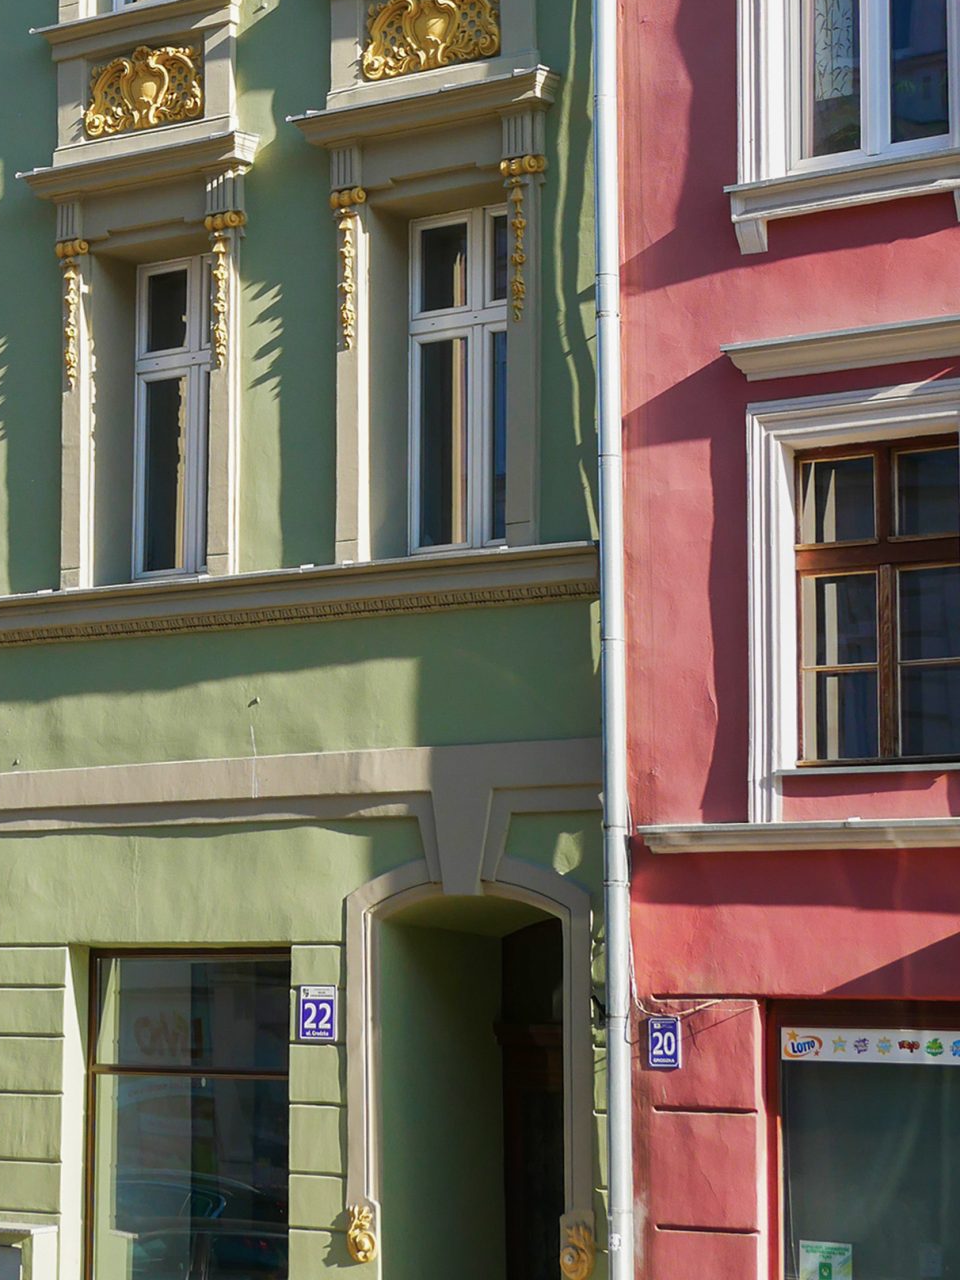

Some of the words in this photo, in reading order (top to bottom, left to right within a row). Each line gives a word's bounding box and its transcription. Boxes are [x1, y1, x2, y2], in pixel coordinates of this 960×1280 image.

[304, 1002, 331, 1029] 22
[652, 1031, 676, 1055] 20
[791, 1040, 815, 1053] LOTTO
